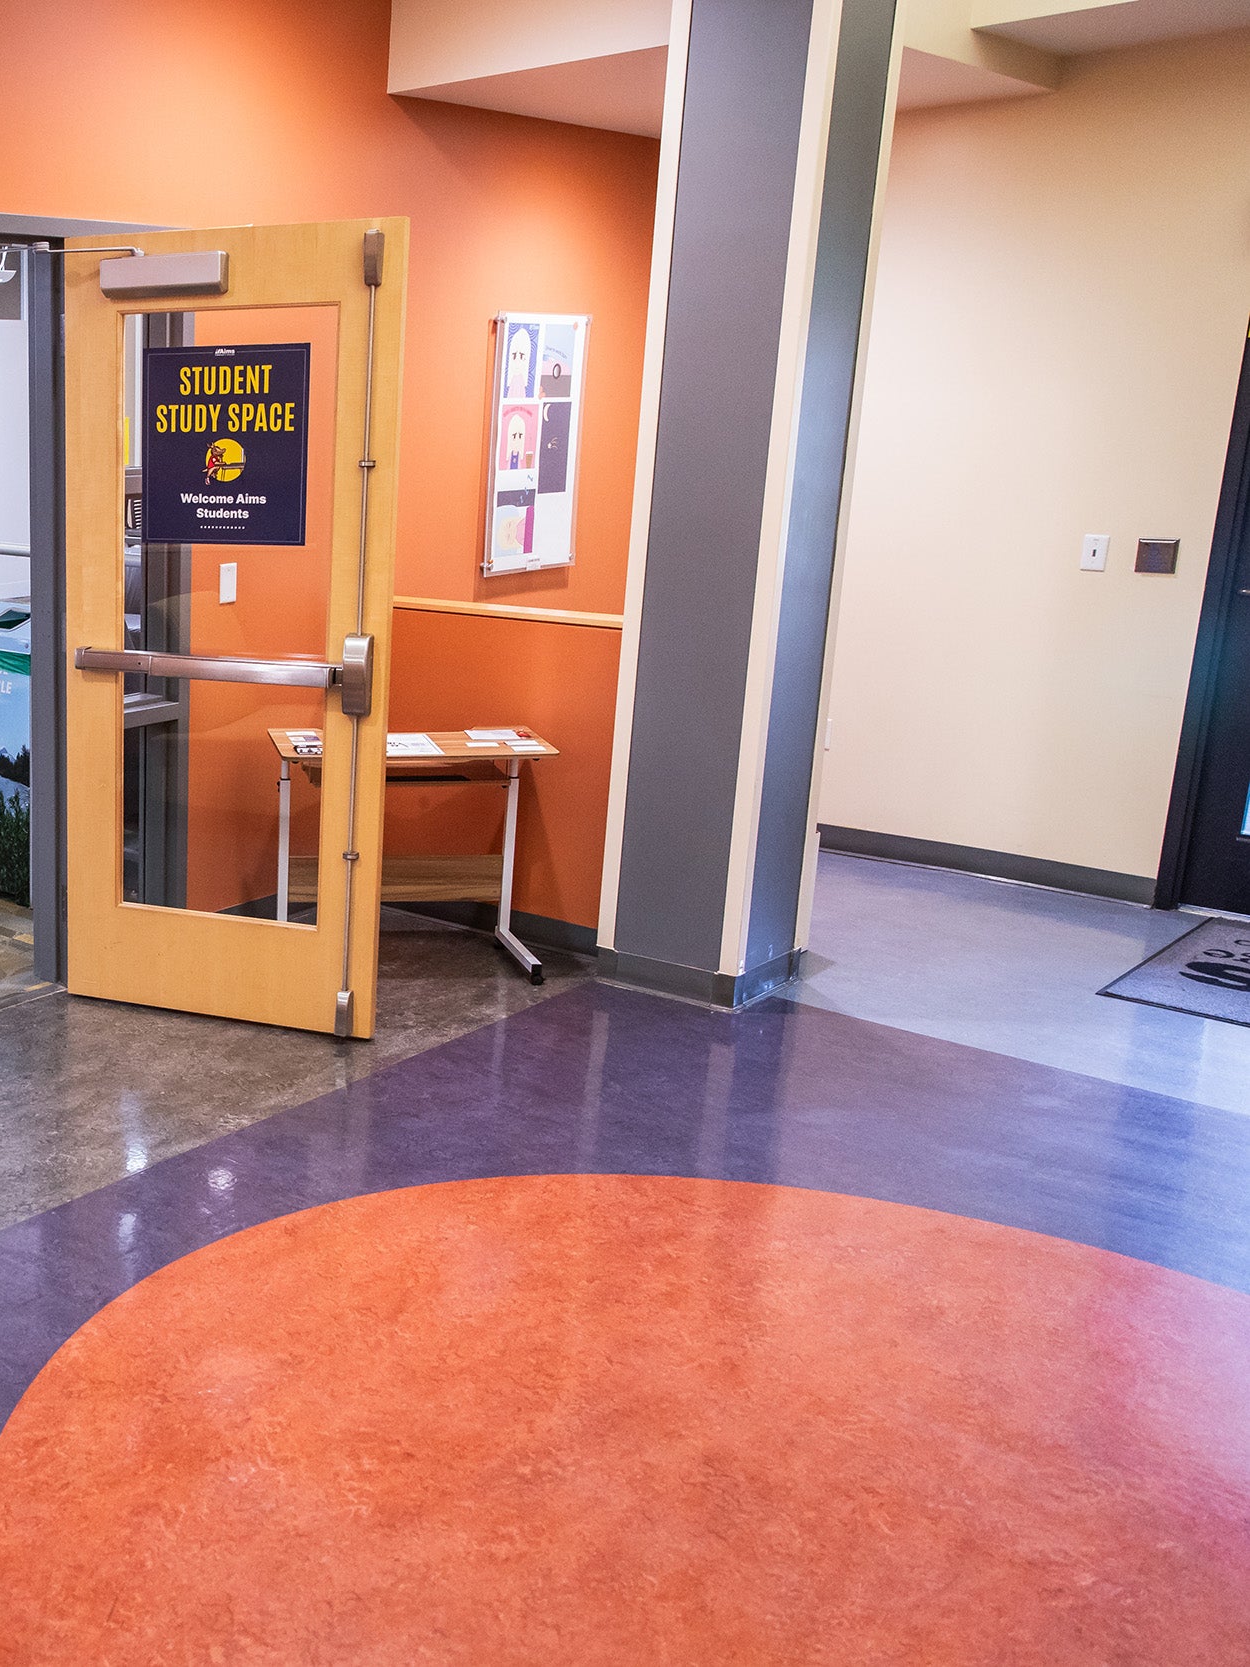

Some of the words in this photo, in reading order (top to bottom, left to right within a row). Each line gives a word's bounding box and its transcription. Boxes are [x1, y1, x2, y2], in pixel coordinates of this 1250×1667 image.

[179, 364, 273, 396] STUDENT
[156, 404, 222, 433] STUDY
[227, 402, 296, 432] SPACE
[180, 492, 234, 504] Welcome
[235, 493, 267, 504] Aims
[196, 508, 249, 519] Students
